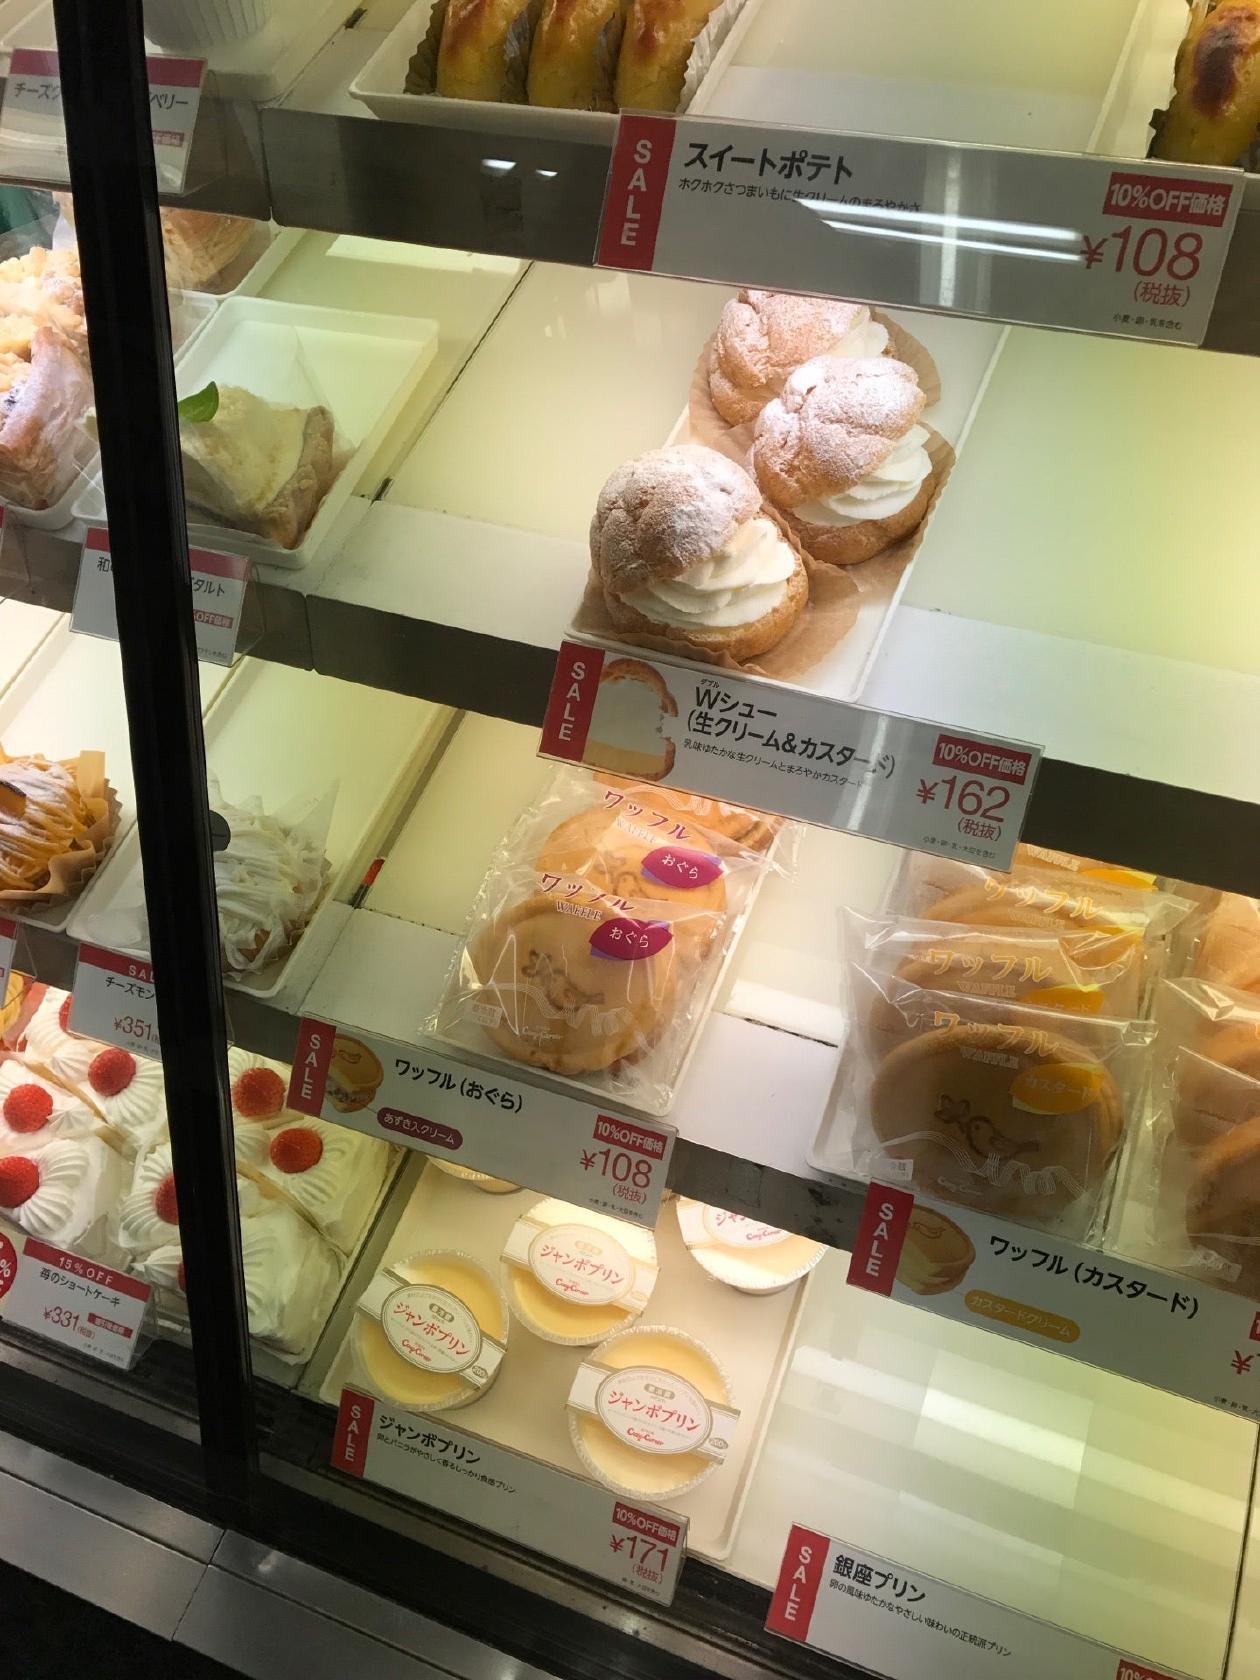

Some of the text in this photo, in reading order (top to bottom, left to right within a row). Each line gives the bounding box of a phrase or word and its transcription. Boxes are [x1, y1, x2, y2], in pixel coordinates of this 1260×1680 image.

[150, 91, 188, 110] ベリー
[684, 142, 853, 185] スイートポテト
[620, 139, 653, 246] SALE
[1109, 183, 1227, 217] 10%OFF価格
[1080, 225, 1204, 281] ¥108
[1134, 281, 1191, 308] (税抜)
[97, 556, 226, 597] 和 タルト
[558, 661, 586, 742] SALE
[695, 686, 778, 719] Wシュー
[687, 708, 896, 779] (生クリーム&カスタード)
[937, 742, 1027, 777] 10%OFF価格
[604, 790, 691, 840] ワッフル
[916, 775, 1010, 823] ¥162
[957, 816, 1002, 842] (税抜)
[661, 853, 699, 879] おぐら
[984, 876, 1104, 920] ワッフル
[609, 926, 650, 949] おぐら
[128, 964, 155, 982] SAL
[929, 948, 1053, 983] ワッフル
[114, 1016, 152, 1041] ¥351
[301, 1033, 321, 1100] SALE
[395, 1058, 523, 1114] ワッフル(おぐら)
[384, 1112, 455, 1145] あずき入クリーム
[597, 1120, 664, 1154] 10%OFF価格
[579, 1147, 653, 1189] ¥108
[865, 1202, 895, 1277] SALE
[540, 1244, 625, 1285] ジャンボプリン
[989, 1235, 1199, 1320] ワッフル(カスタード)
[43, 1304, 80, 1332] ¥331
[393, 1301, 470, 1356] ジャンボプリン
[970, 1294, 1072, 1337] カスタードクリーム
[607, 1390, 701, 1432] ジャンボプリン
[345, 1404, 361, 1462] SALE
[379, 1414, 481, 1464] ジャンボプリン
[615, 1507, 678, 1542] 10%OFF価格
[610, 1534, 669, 1572] ¥171
[785, 1545, 813, 1622] SALE
[832, 1554, 927, 1603] 銀座プリン
[829, 1577, 1013, 1657] 卵の風味ゆたかなやさしい味わいの正統派プリン
